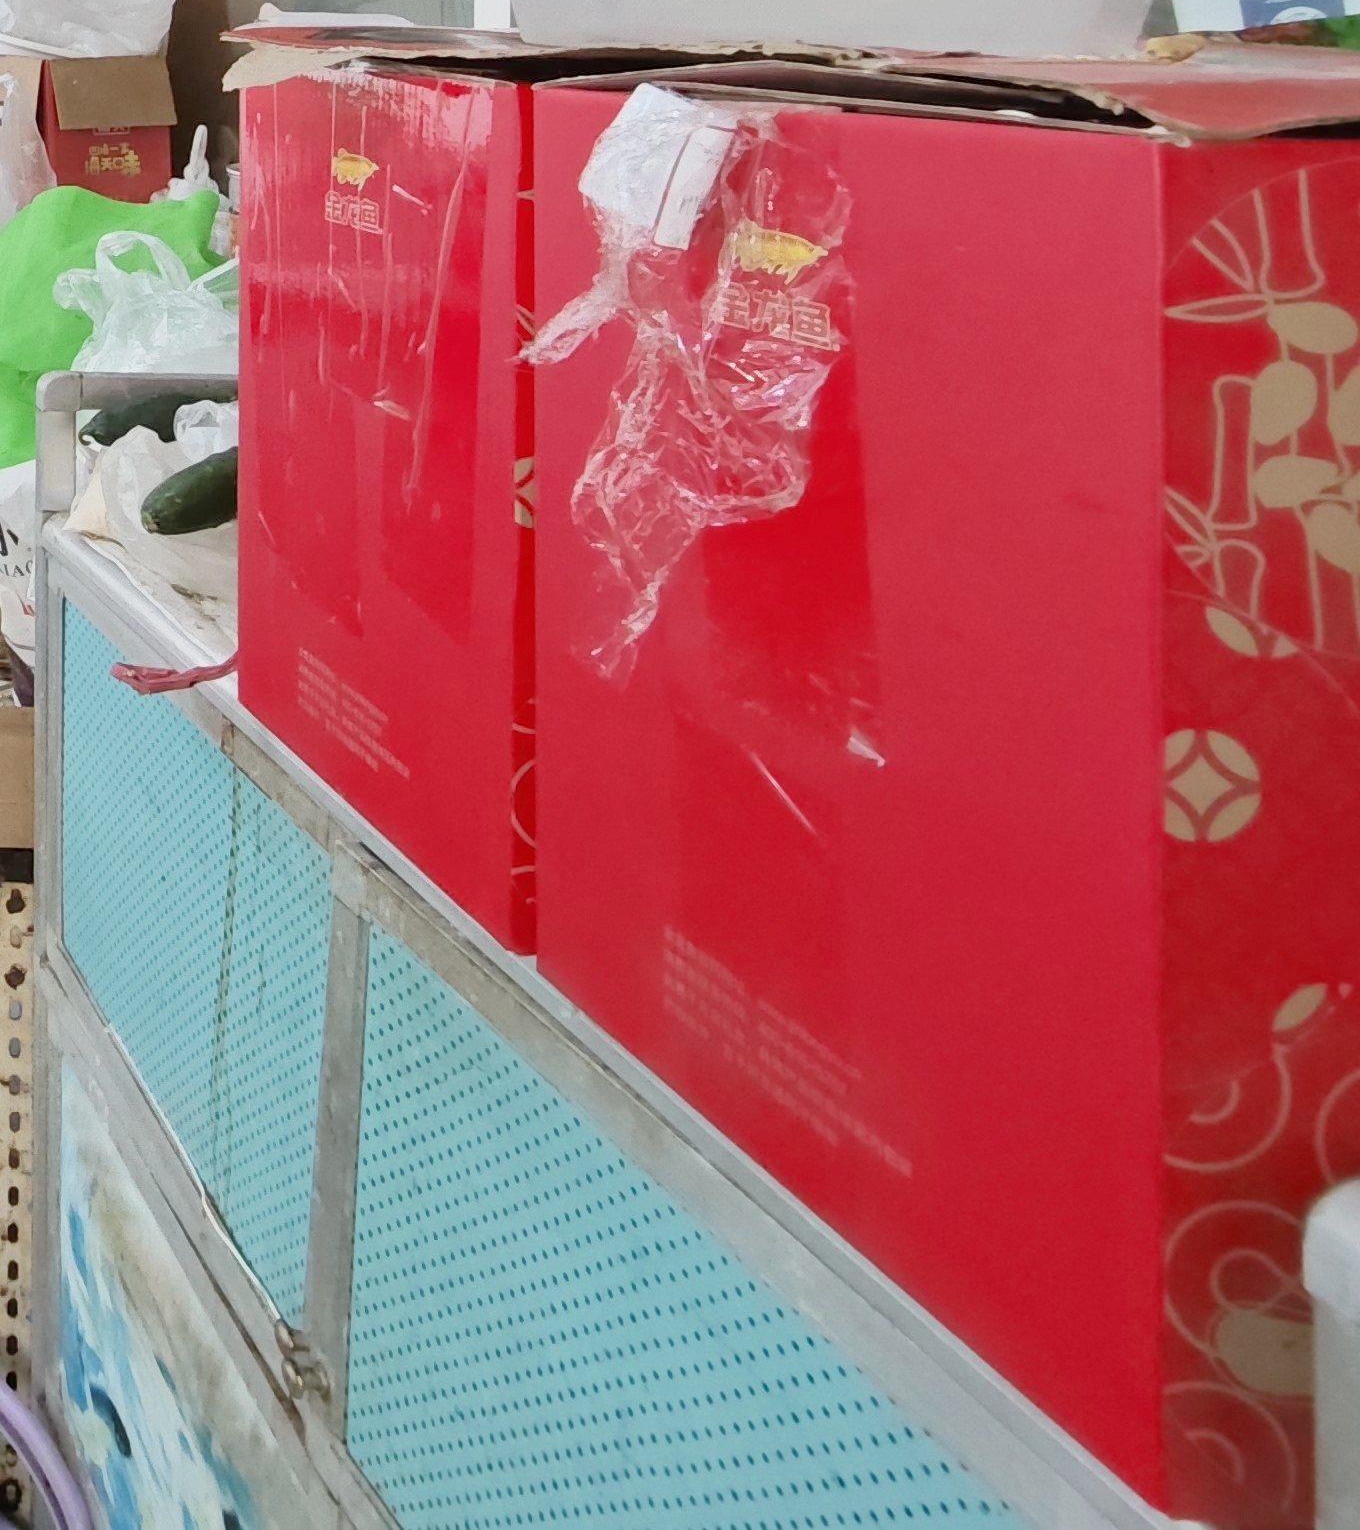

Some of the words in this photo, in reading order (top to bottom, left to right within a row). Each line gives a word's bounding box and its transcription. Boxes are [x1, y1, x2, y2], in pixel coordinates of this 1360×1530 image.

[325, 190, 382, 233] 金龙鱼
[714, 281, 832, 350] 金龙鱼
